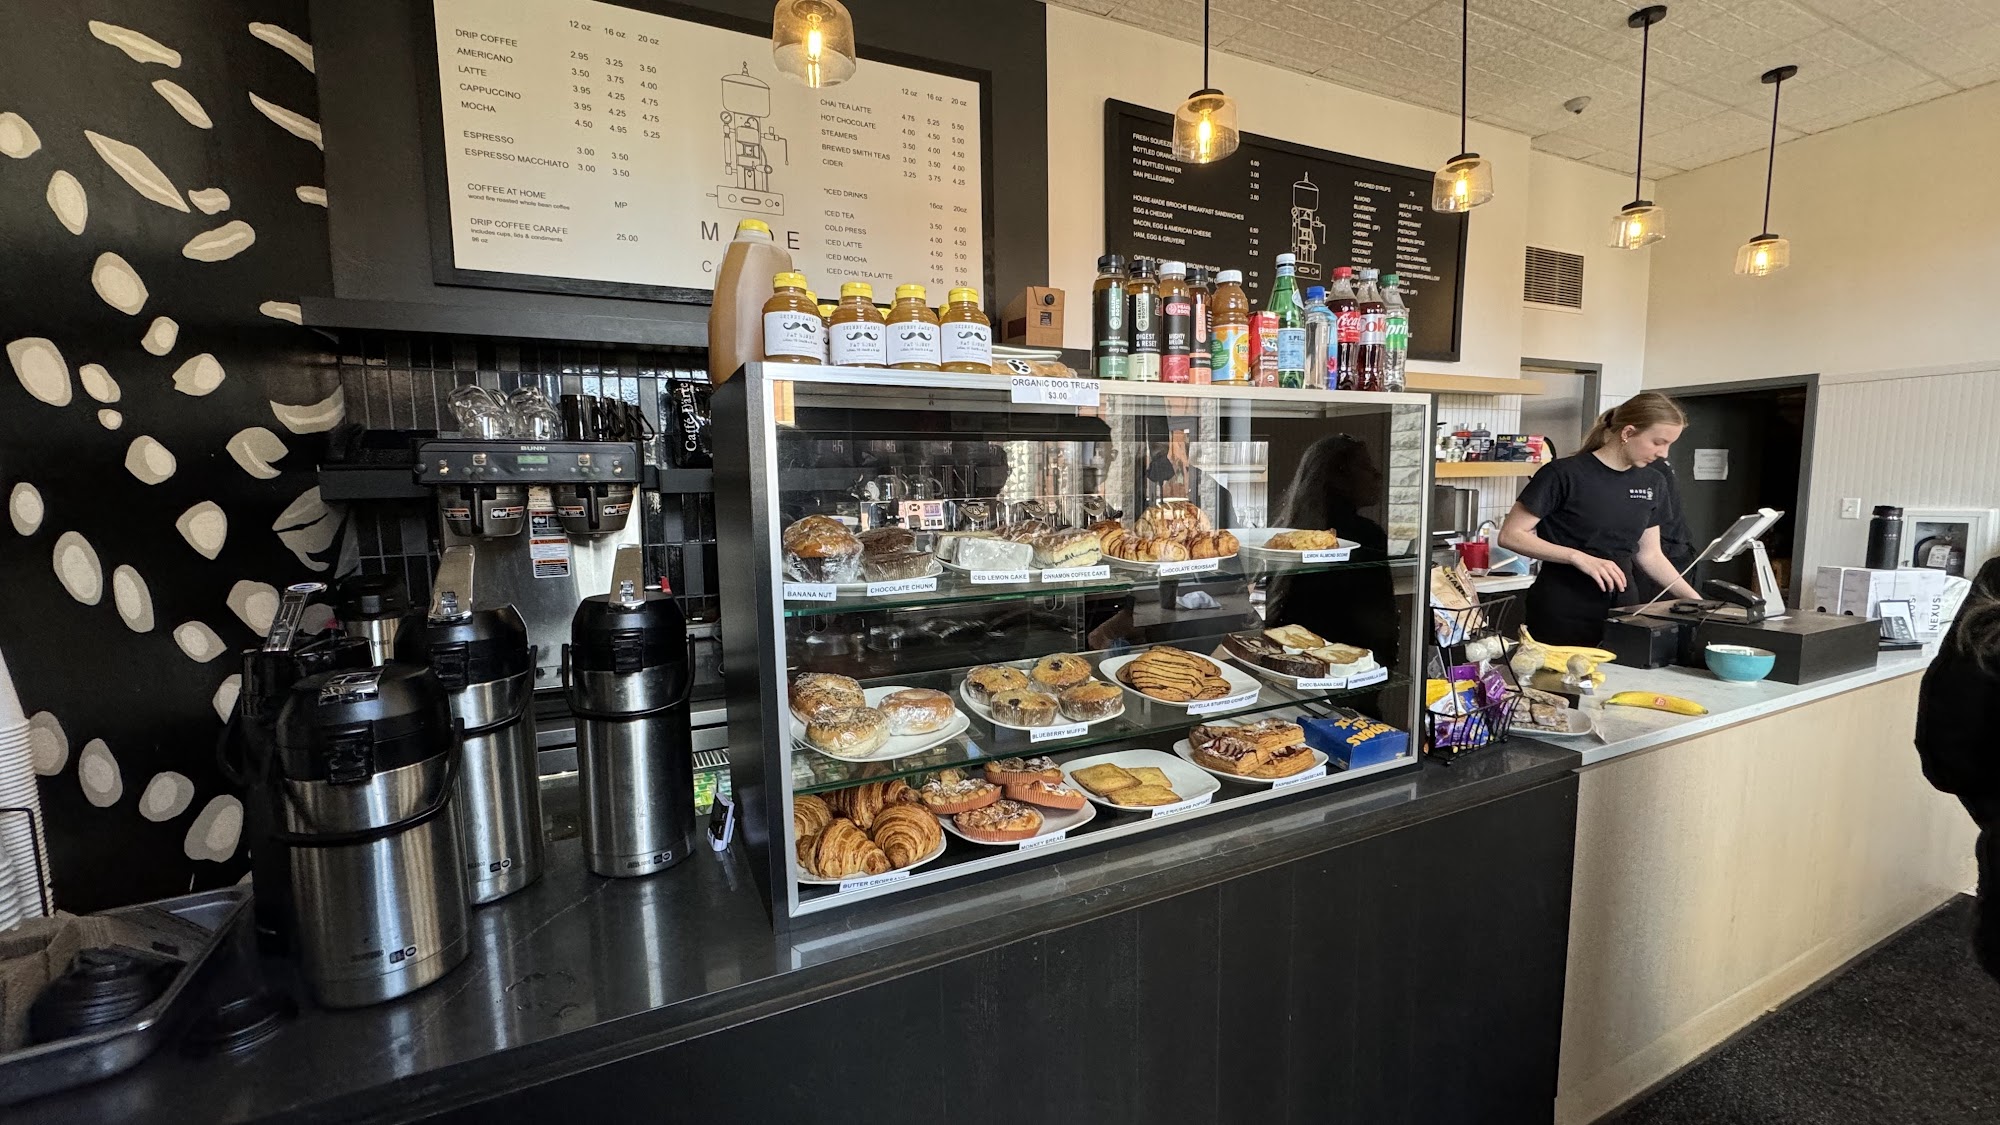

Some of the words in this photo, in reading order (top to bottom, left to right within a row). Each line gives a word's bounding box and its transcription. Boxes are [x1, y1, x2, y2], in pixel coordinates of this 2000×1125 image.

[569, 20, 578, 28] 12
[580, 23, 592, 31] oz
[604, 27, 614, 35] 16
[615, 30, 626, 39] oz
[455, 29, 478, 40] DRIP
[480, 33, 518, 47] COFFEE
[638, 34, 647, 42] 20
[650, 37, 659, 45] oz
[457, 47, 513, 64] AMERICANO
[570, 51, 589, 61] 2.95
[605, 58, 623, 67] 3.25
[458, 66, 487, 77] LATTE
[571, 68, 590, 78] 3.50
[639, 64, 657, 74] 3.50
[606, 75, 625, 84] 3.75
[572, 85, 591, 95] 3.95
[640, 81, 658, 91] 4.00
[460, 83, 521, 100] CAPPUCCINO
[607, 91, 625, 101] 4.25
[461, 101, 496, 112] MOCHA
[641, 97, 658, 107] 4.75
[820, 99, 837, 108] CHAI
[838, 102, 850, 111] TEA
[850, 105, 872, 114] LATTE
[573, 102, 592, 112] 3.95
[609, 108, 626, 117] 4.25
[642, 114, 659, 123] 4.75
[821, 114, 835, 123] HOT
[837, 116, 876, 129] CHOCOLATE
[902, 114, 915, 122] 4.75
[927, 118, 940, 126] 5.25
[575, 119, 593, 128] 4.50
[610, 125, 627, 134] 4.95
[463, 130, 514, 144] ESPRESSO
[643, 130, 660, 139] 5.25
[821, 129, 858, 140] STEAMERS
[927, 133, 940, 141] 4.50
[1133, 133, 1150, 141] FRESH
[952, 137, 964, 145] 5.00
[576, 147, 595, 156] 3.00
[822, 144, 851, 155] BREWED
[852, 148, 872, 158] SMITH
[873, 151, 890, 160] TEAS
[1133, 146, 1155, 156] BOTTLED
[464, 148, 515, 162] ESPRESSO
[517, 155, 569, 169] MACCHIATO
[612, 152, 629, 161] 3.50
[823, 159, 843, 167] CIDER
[1142, 160, 1164, 170] BOTTLED
[1165, 165, 1182, 173] WATER
[578, 164, 596, 173] 3.00
[612, 169, 630, 177] 3.50
[903, 171, 916, 179] 3.25
[1144, 173, 1174, 184] PELLEGRINO
[953, 178, 965, 186] 4.25
[467, 183, 505, 195] COFFEE
[507, 188, 517, 196] AT
[520, 189, 546, 199] HOME
[844, 190, 868, 199] DRINKS
[614, 201, 627, 209] MP
[929, 202, 943, 211] 16oz
[953, 205, 967, 213] 20oz
[825, 210, 839, 218] ICED
[840, 211, 855, 219] TEA
[1150, 210, 1173, 219] CHEDDAR
[470, 217, 492, 227] DRIP
[494, 220, 531, 230] COFFEE
[533, 224, 568, 234] CARAFE
[825, 224, 843, 233] COLD
[844, 227, 866, 235] PRESS
[930, 223, 943, 231] 3.50
[1168, 225, 1192, 234] AMERICAN
[1193, 229, 1211, 238] CHEESE
[616, 233, 638, 242] 25.00
[930, 236, 943, 244] 4.00
[826, 239, 841, 247] ICED
[842, 241, 862, 249] LATTE
[930, 250, 943, 258] 4.50
[843, 255, 867, 263] MOCHA
[931, 277, 944, 285] 4.95
[1012, 379, 1049, 387] ORGANIC
[684, 418, 697, 451] Caffé
[1162, 566, 1190, 574] CHOCOLATE
[1191, 563, 1217, 571] CROISSANT
[871, 585, 909, 593] CHOCOLATE
[1929, 597, 1940, 630] NEXUS
[1032, 731, 1065, 739] BLUEBERRY
[1021, 841, 1044, 850] MONKEY
[1045, 835, 1064, 845] BREAD
